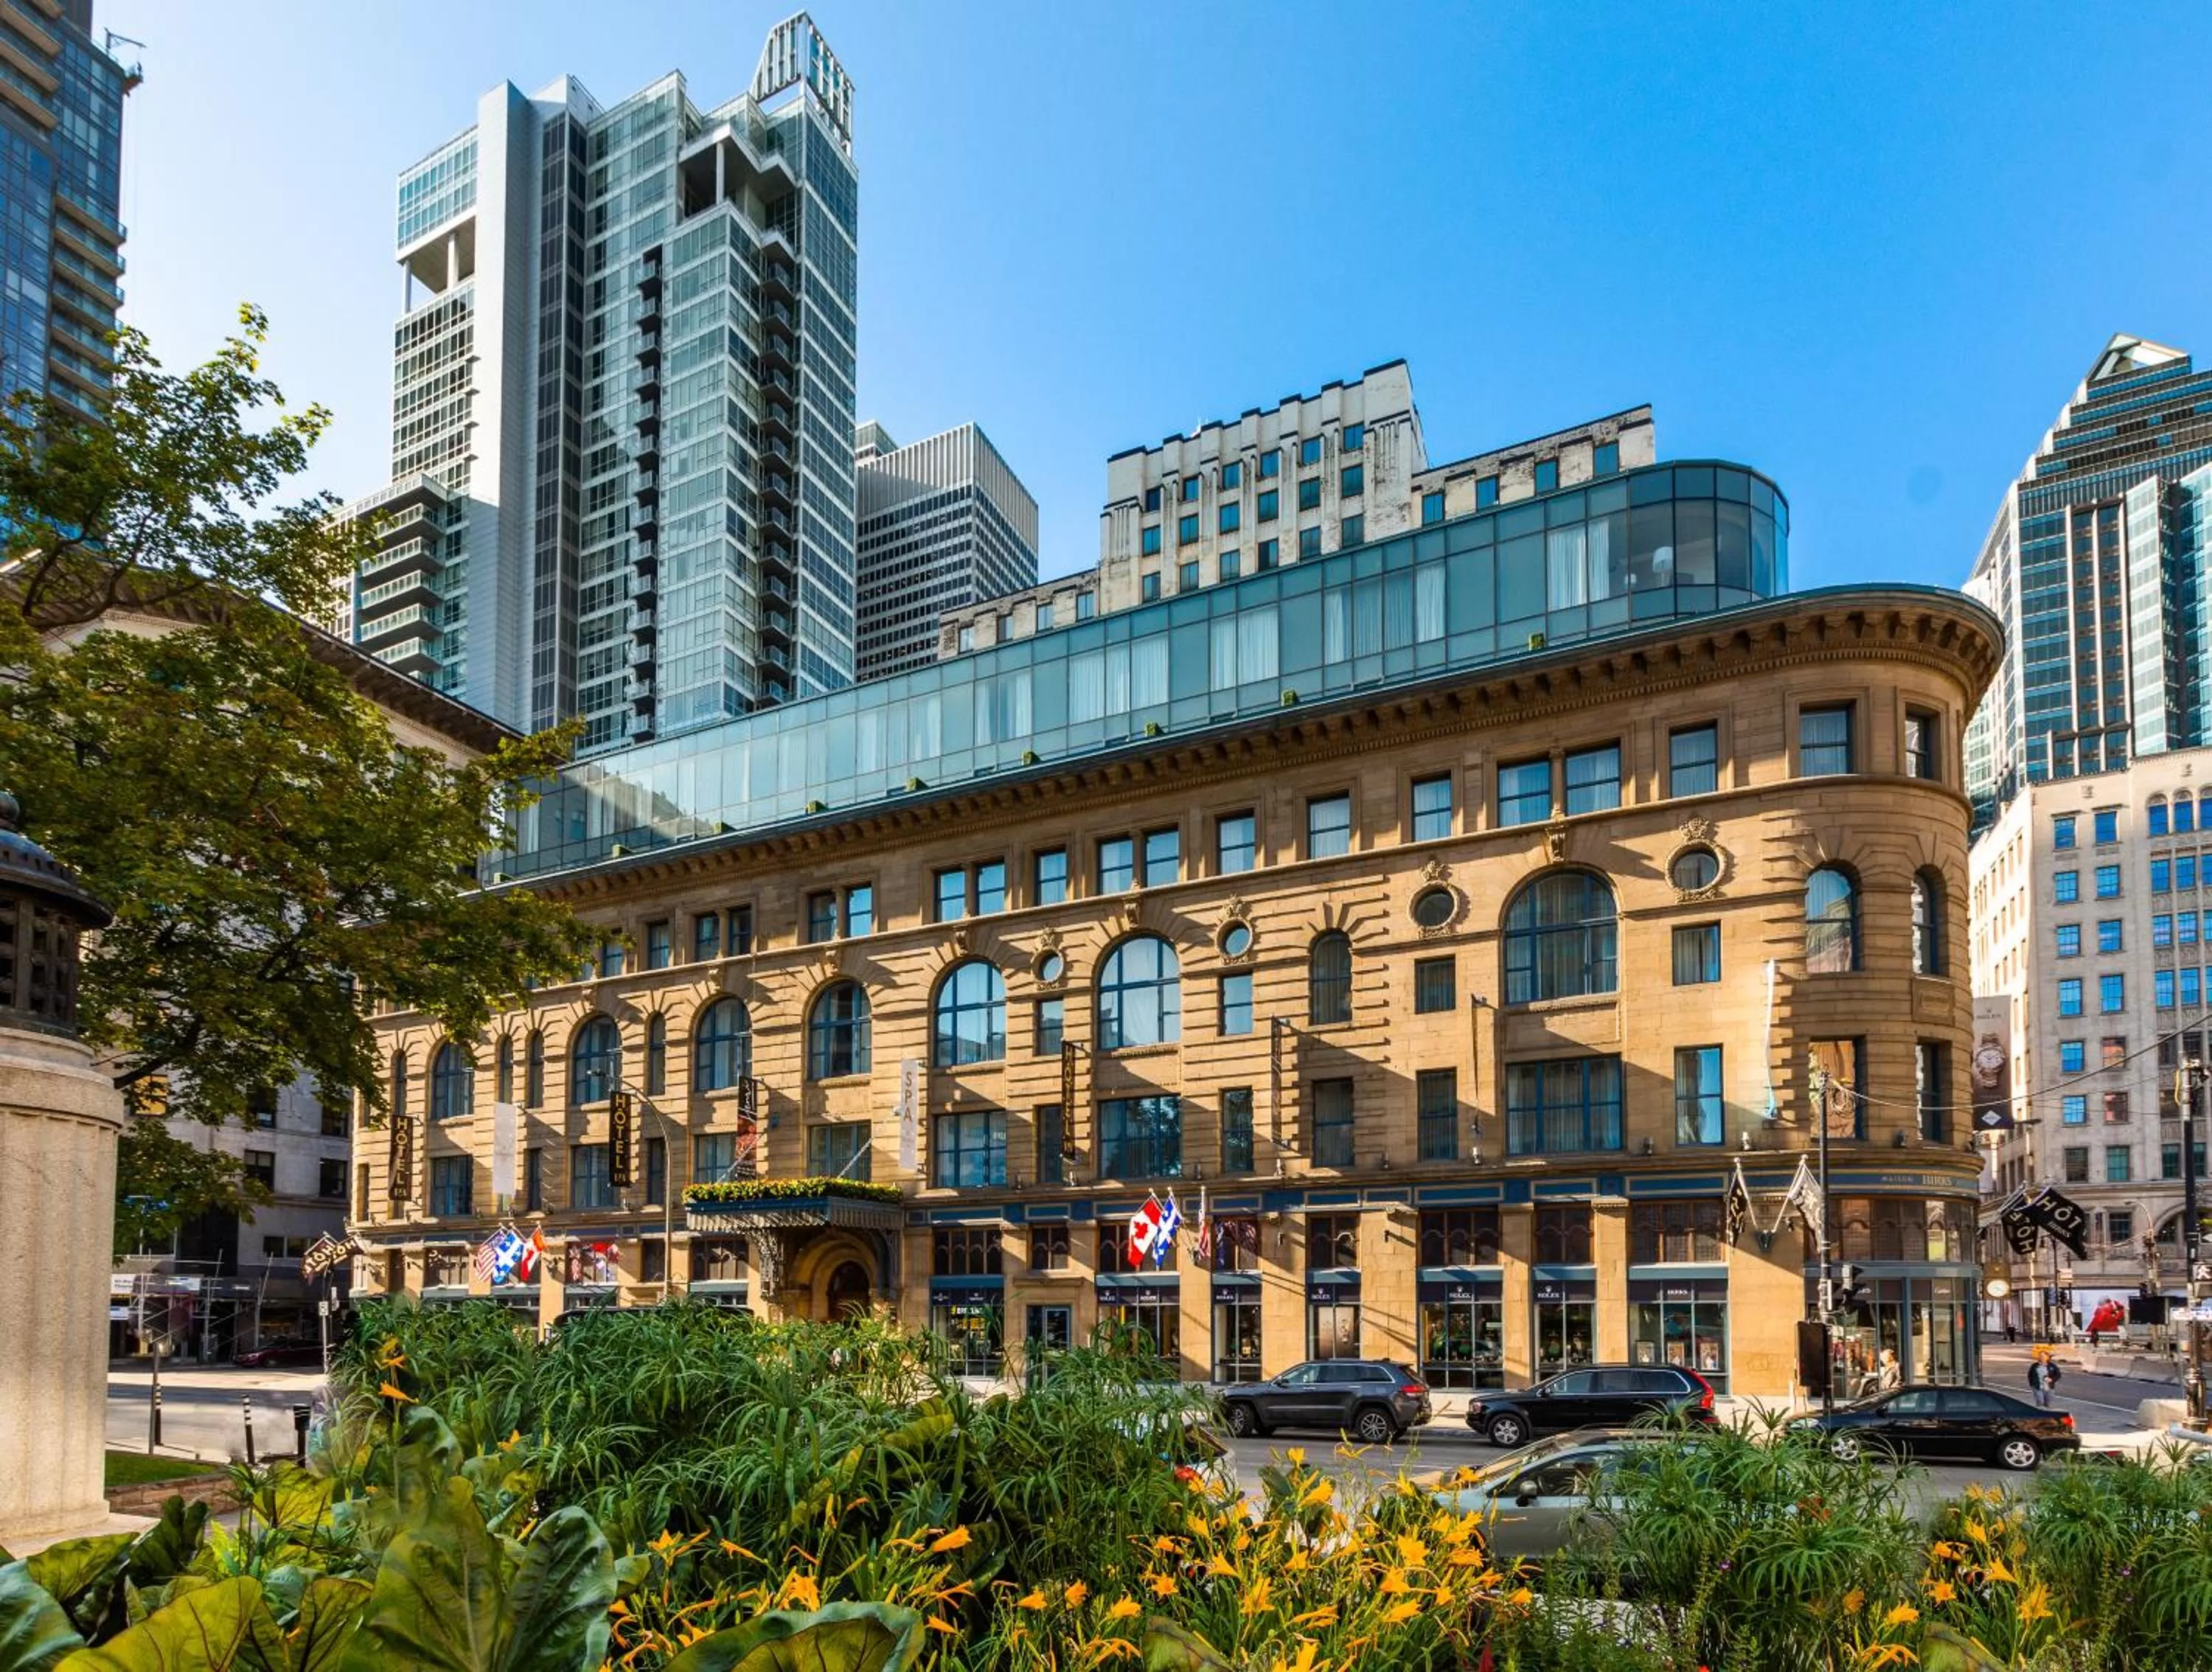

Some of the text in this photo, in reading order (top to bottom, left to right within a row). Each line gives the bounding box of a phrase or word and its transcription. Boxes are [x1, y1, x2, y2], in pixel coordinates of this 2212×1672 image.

[903, 1072, 913, 1122] SPA
[395, 1117, 408, 1185] HÔTEL
[614, 1094, 627, 1169] HÔTEL
